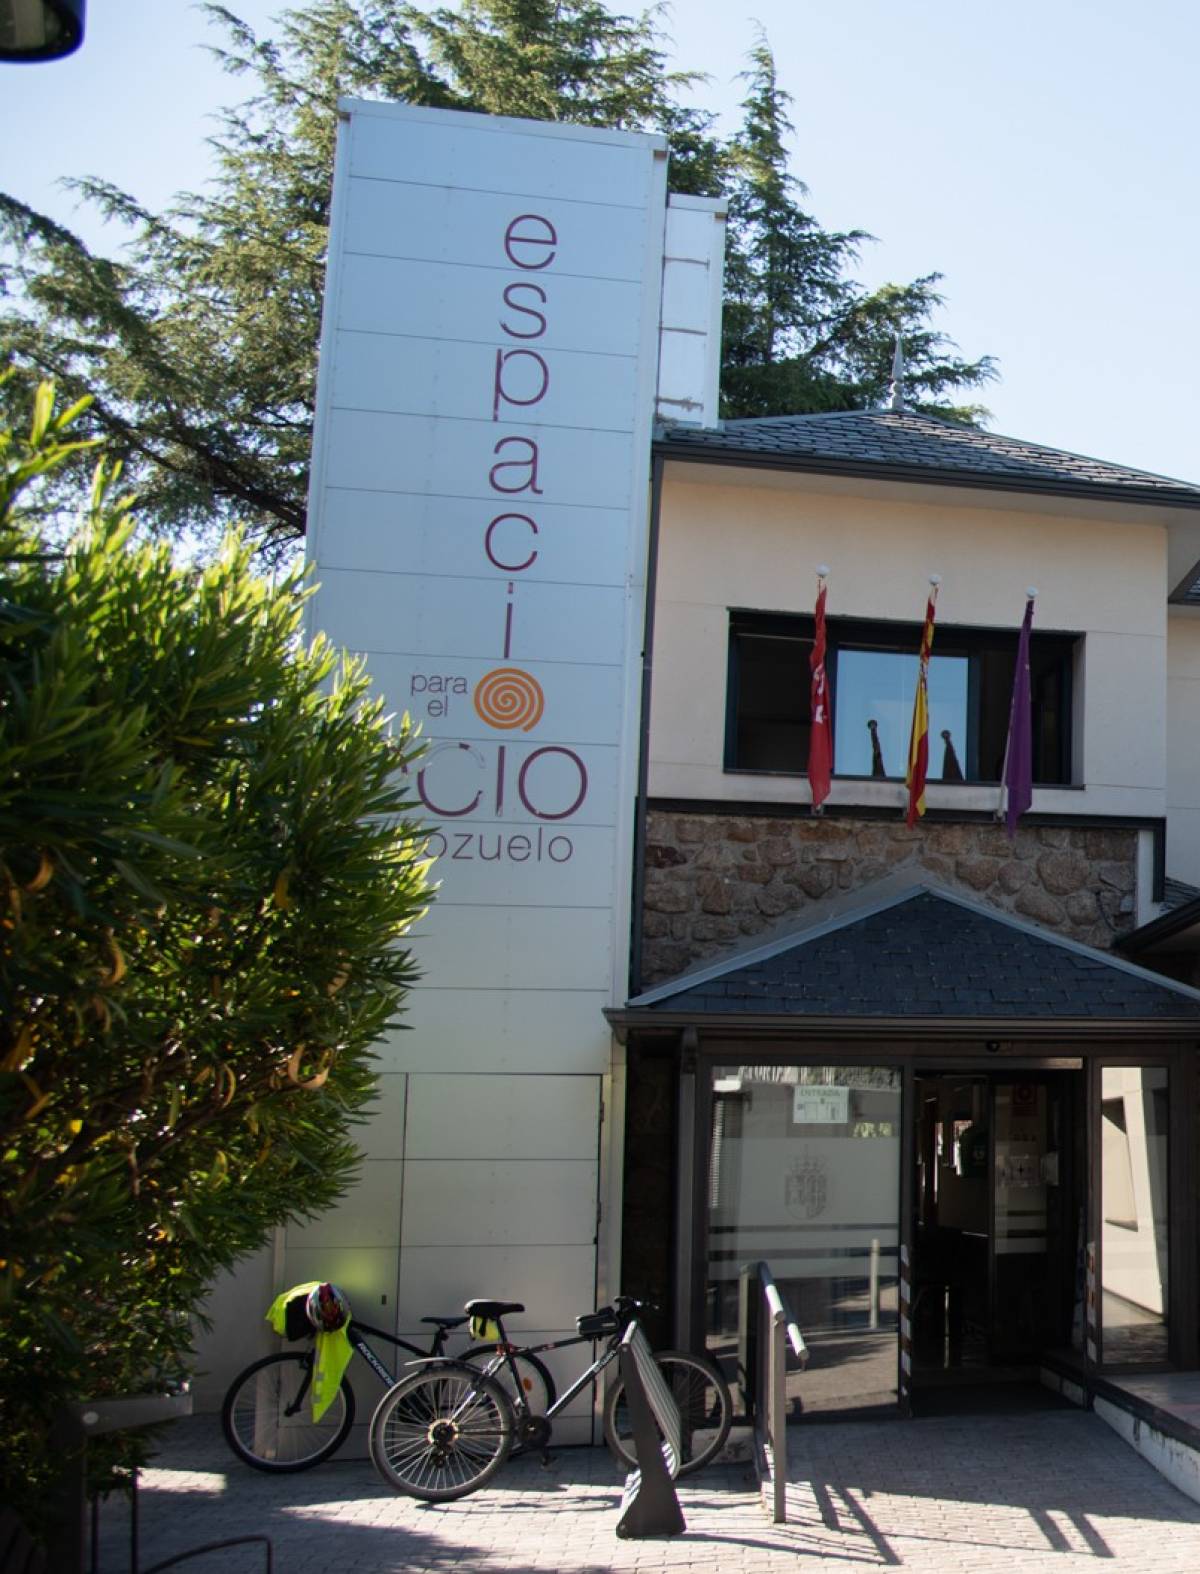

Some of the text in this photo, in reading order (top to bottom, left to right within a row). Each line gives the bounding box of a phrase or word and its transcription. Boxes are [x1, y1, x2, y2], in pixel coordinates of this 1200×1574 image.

[410, 674, 468, 695] para
[427, 696, 450, 718] el
[388, 741, 588, 820] CIO
[418, 826, 574, 864] ozuelo
